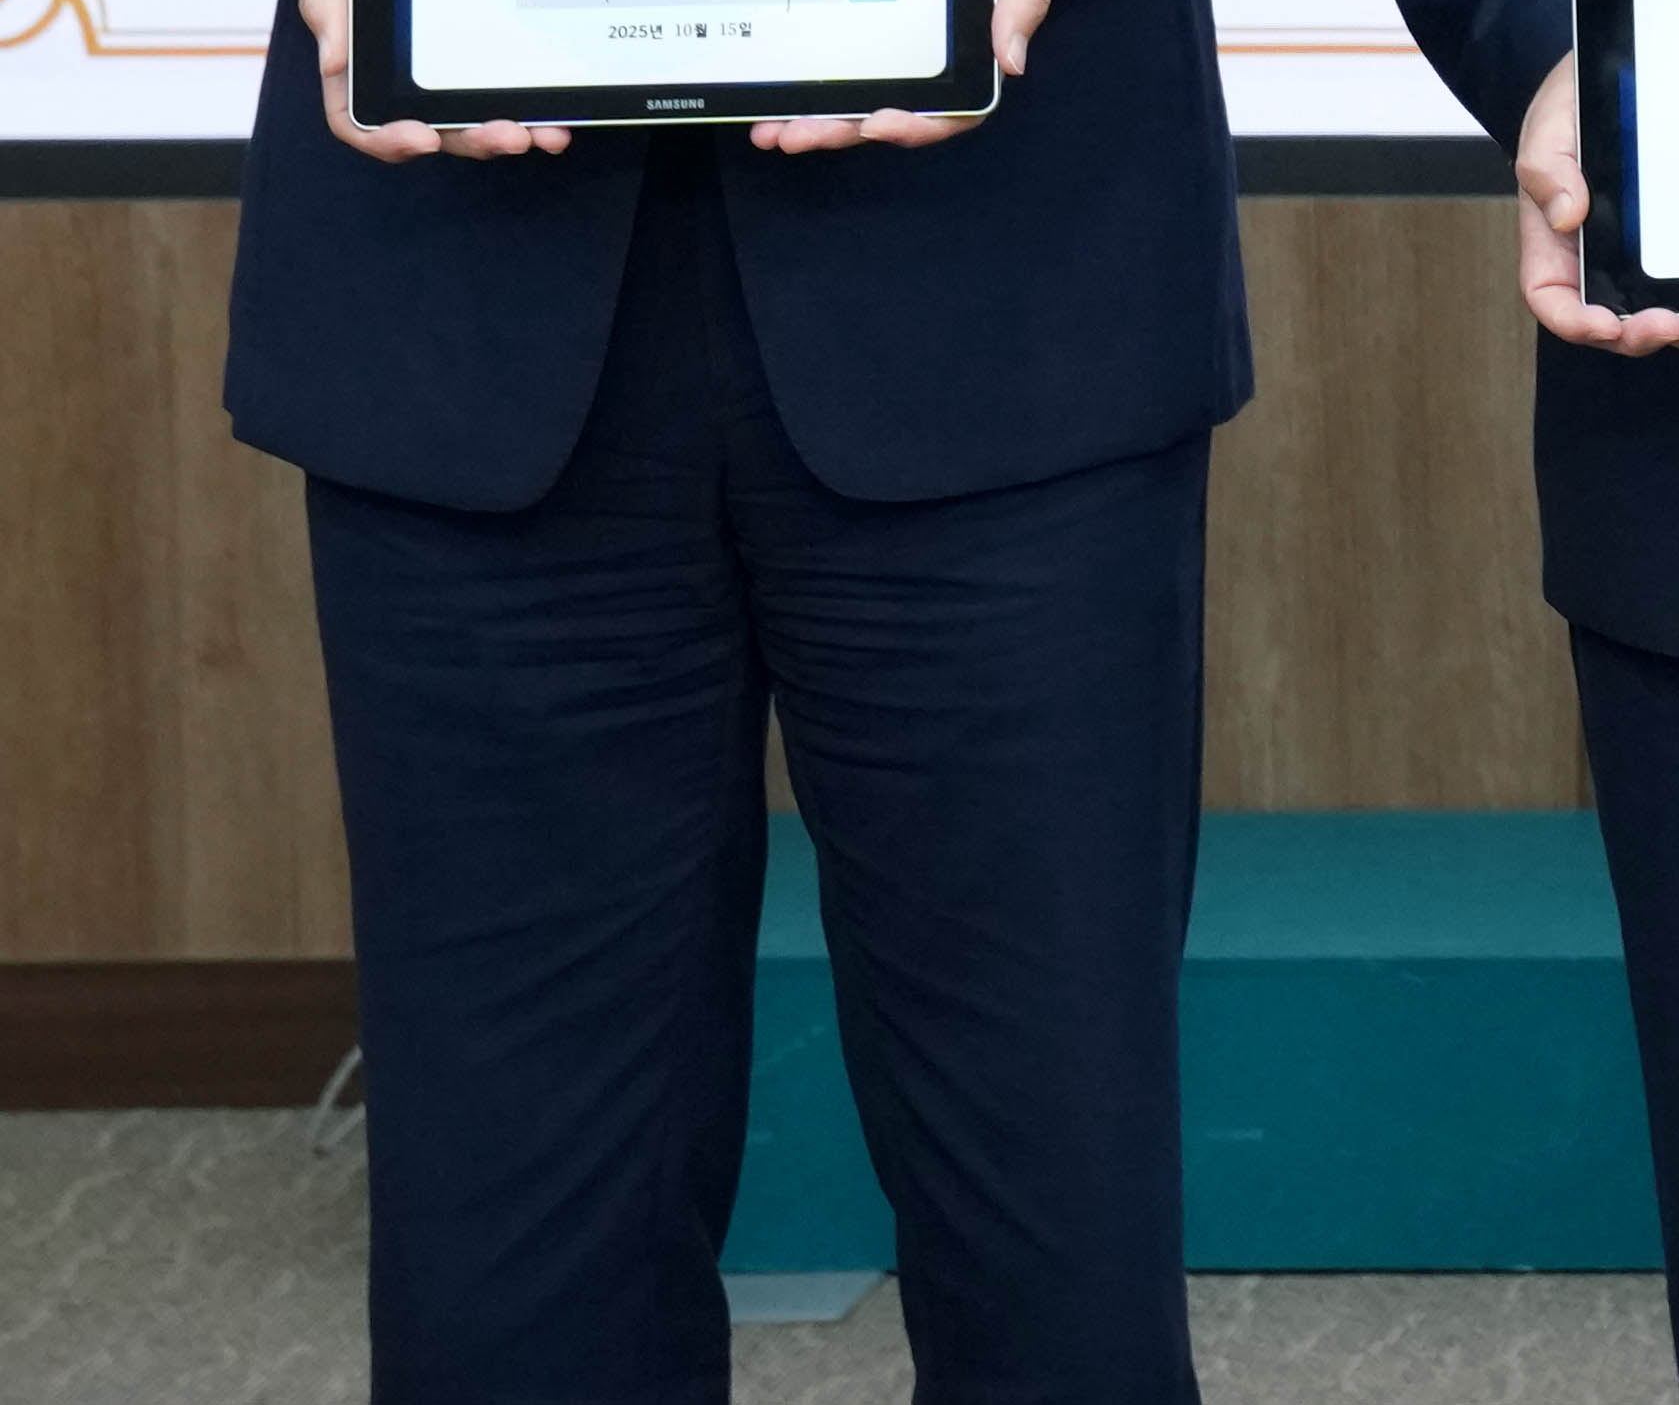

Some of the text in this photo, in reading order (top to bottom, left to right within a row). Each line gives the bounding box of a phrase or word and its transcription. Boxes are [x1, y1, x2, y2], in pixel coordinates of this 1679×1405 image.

[608, 21, 753, 40] 2025년 10월 15일
[646, 98, 705, 110] SAMSUNG
